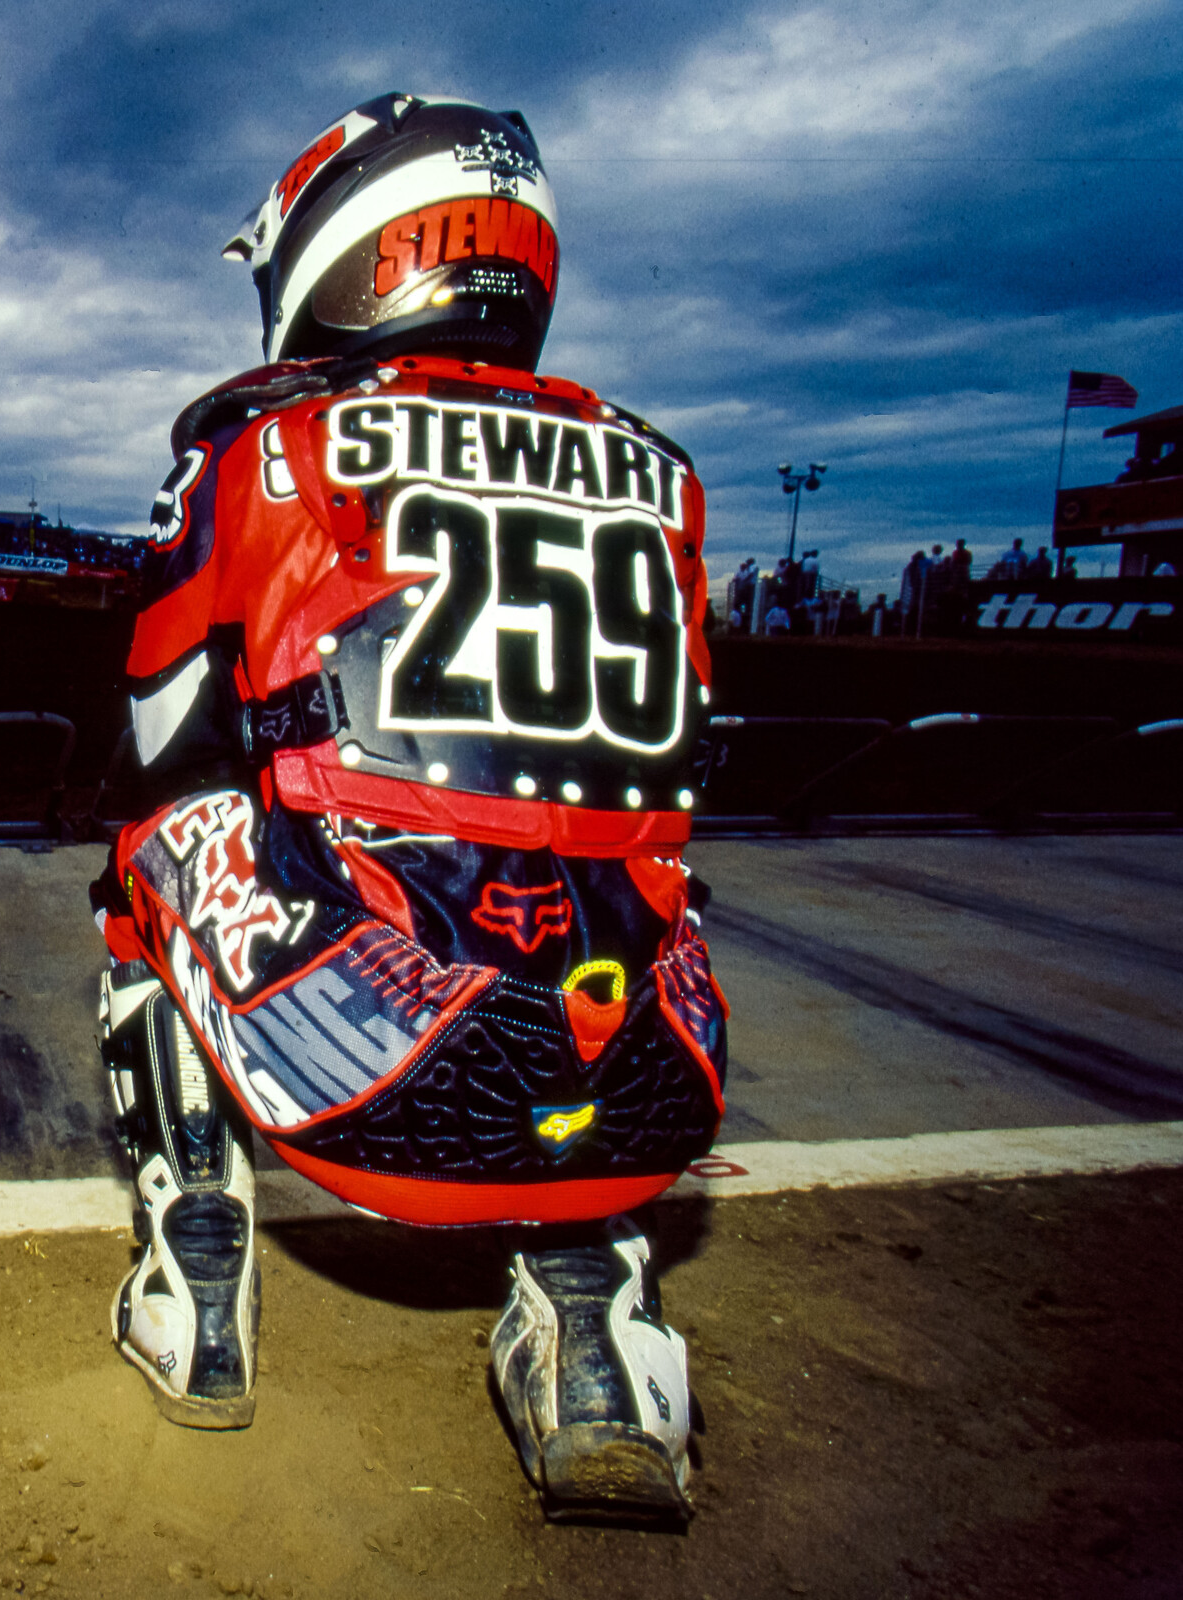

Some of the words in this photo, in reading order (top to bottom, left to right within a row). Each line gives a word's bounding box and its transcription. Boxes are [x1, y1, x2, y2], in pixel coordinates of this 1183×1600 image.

[330, 398, 687, 529] STEWART
[379, 485, 683, 753] 259
[977, 593, 1174, 630] thor
